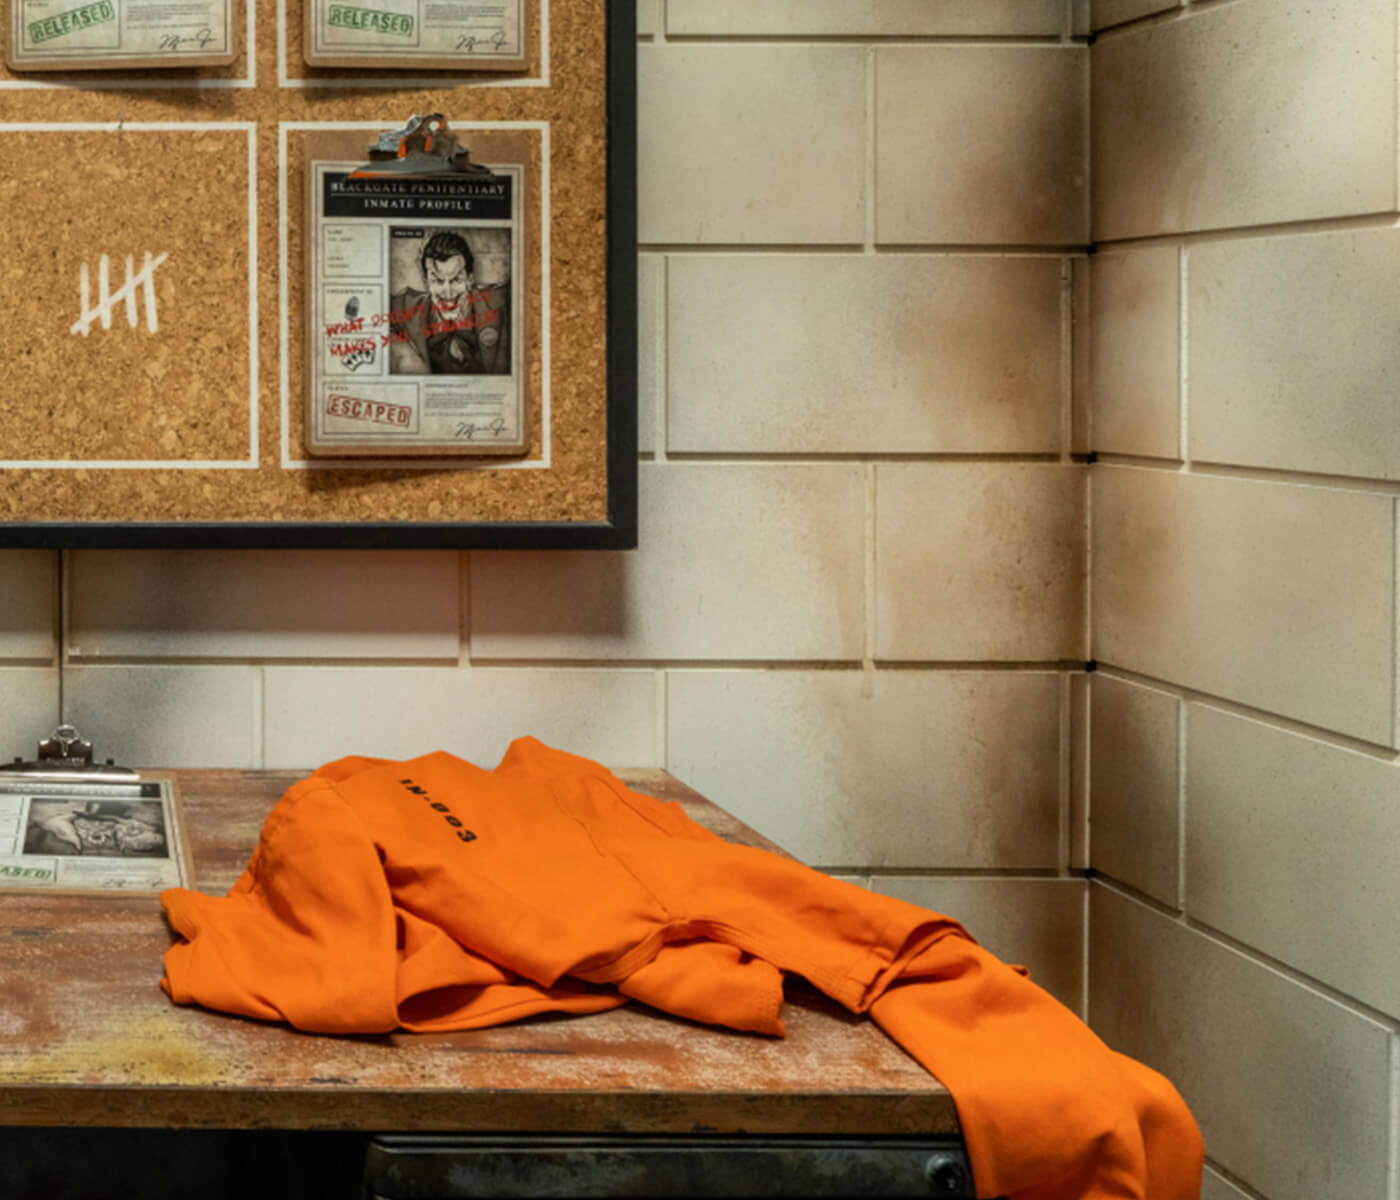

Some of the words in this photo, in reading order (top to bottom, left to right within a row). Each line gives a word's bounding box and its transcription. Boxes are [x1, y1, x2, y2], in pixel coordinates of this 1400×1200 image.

[33, 4, 110, 41] RELEASED
[331, 8, 410, 33] RELEASED
[330, 182, 406, 192] BLACKGATE
[411, 183, 505, 195] PENITENTIARY
[364, 199, 414, 208] INMATE
[419, 200, 472, 210] PROFILE
[326, 317, 365, 338] WHAT
[328, 336, 377, 358] MAKES
[330, 397, 408, 423] ESCAPED
[399, 779, 478, 843] IN-003
